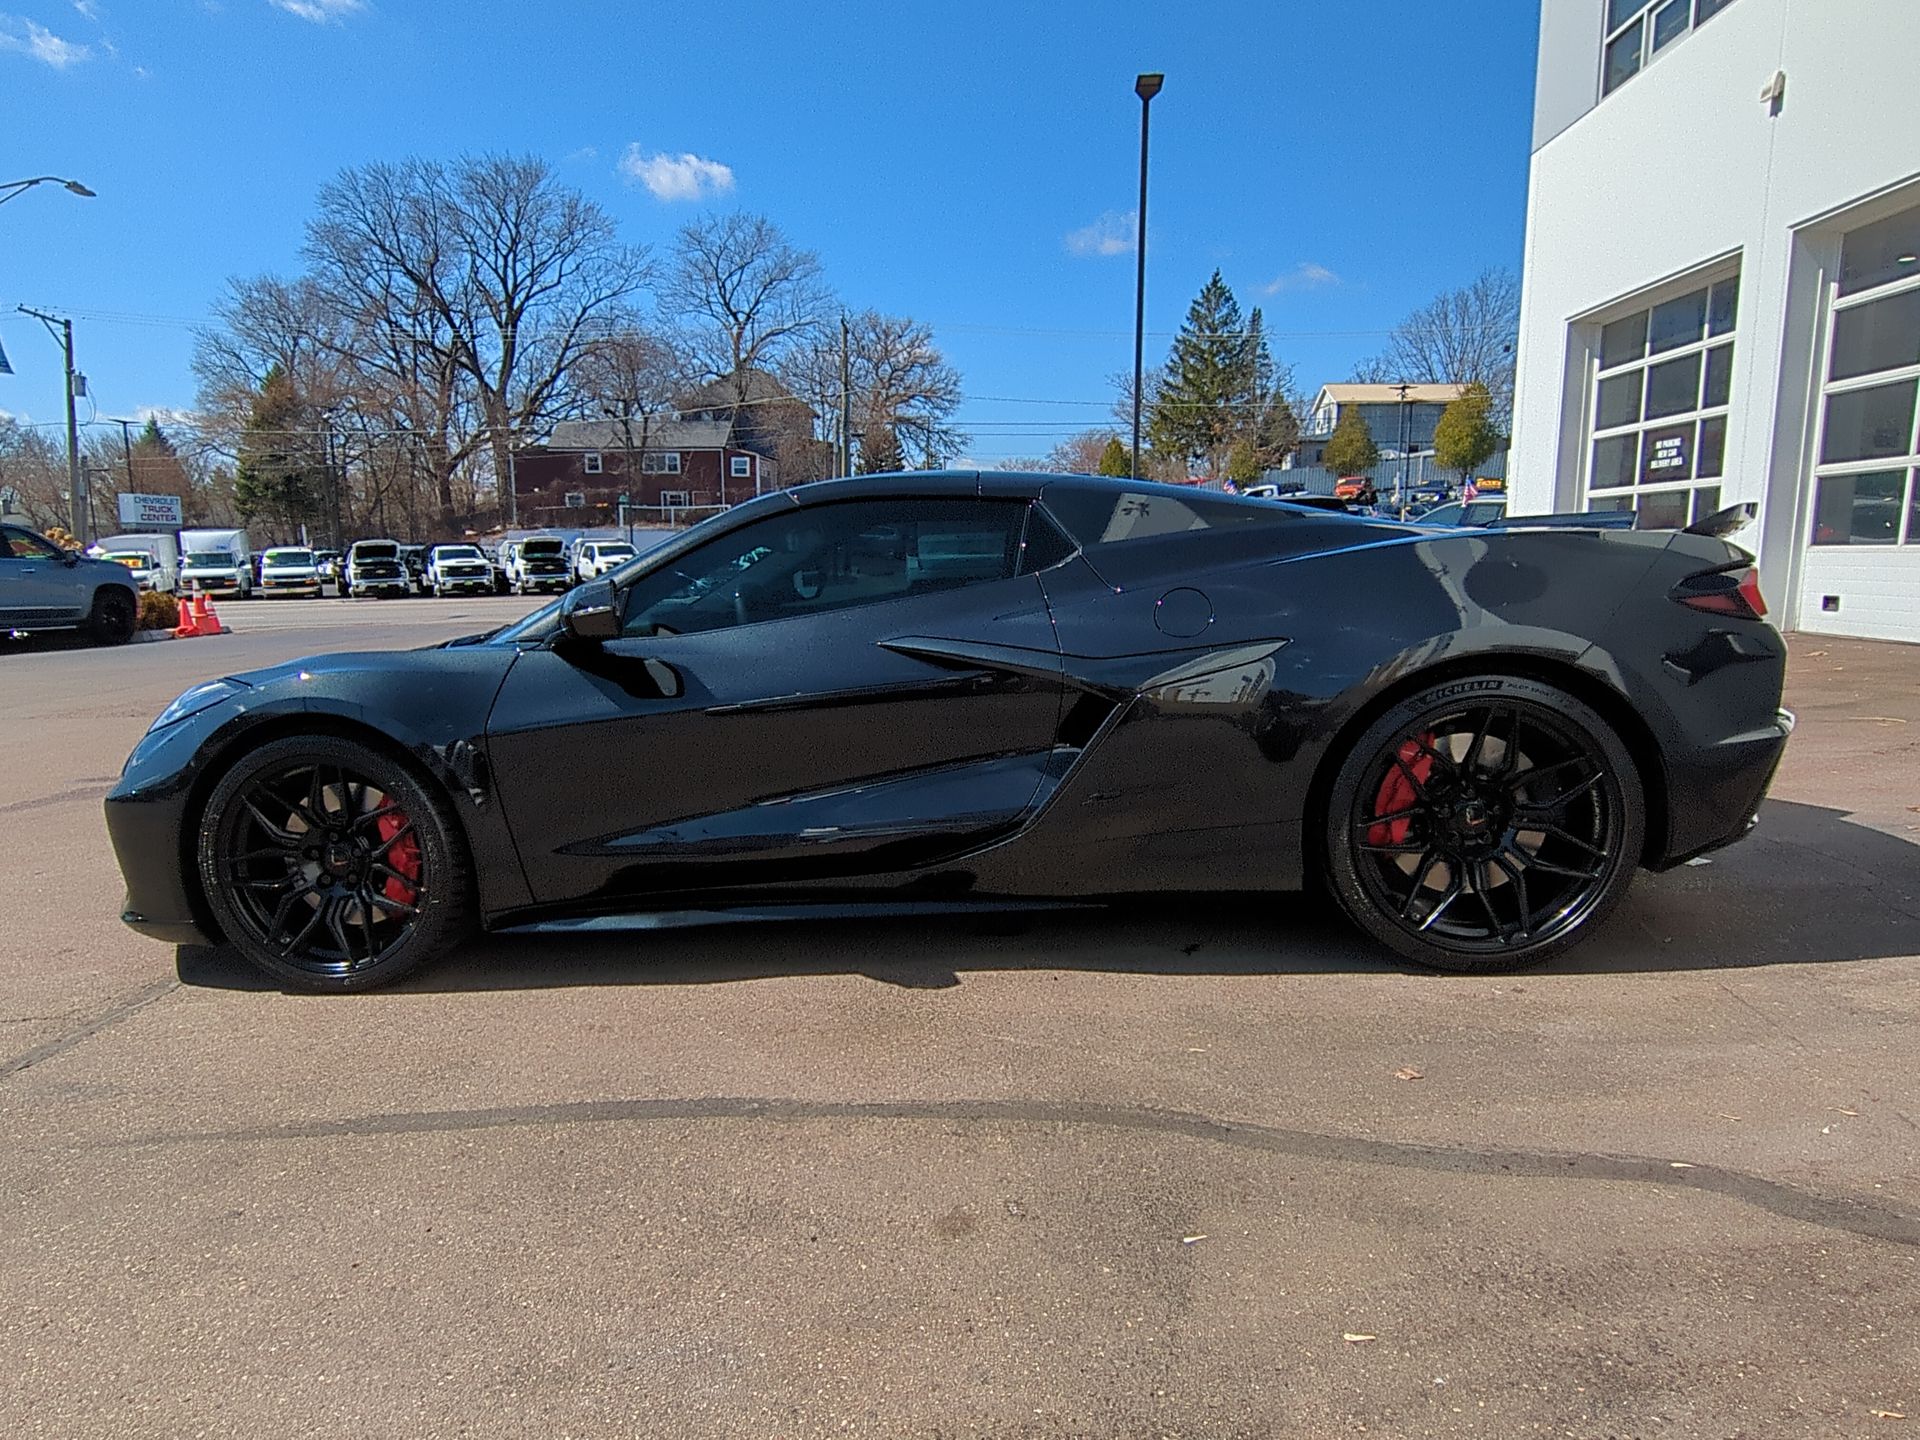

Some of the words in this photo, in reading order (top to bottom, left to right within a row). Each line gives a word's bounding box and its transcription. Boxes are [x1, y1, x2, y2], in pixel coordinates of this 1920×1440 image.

[134, 496, 179, 505] CHEVROLET
[142, 505, 173, 513] TRUCK
[141, 513, 177, 521] CENTER
